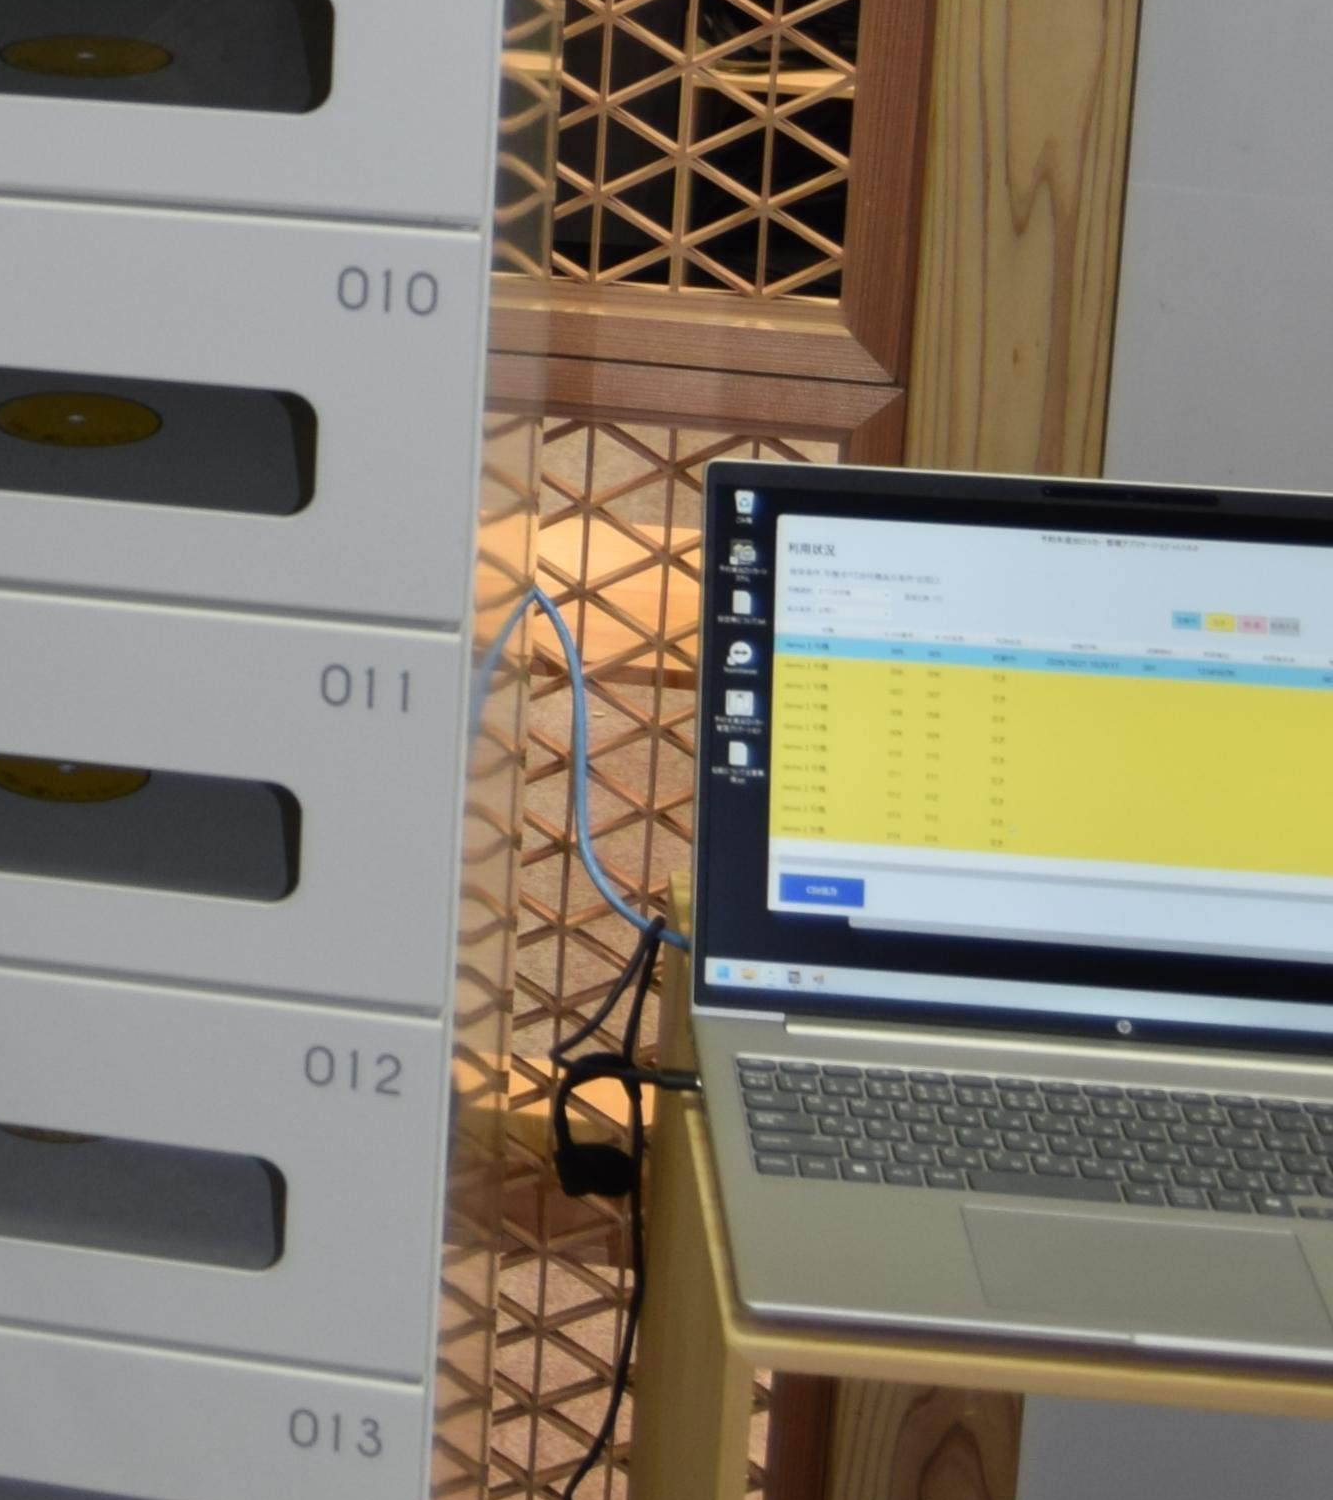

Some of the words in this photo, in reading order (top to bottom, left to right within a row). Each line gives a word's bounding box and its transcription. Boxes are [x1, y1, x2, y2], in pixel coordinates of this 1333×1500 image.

[336, 265, 439, 317] 010
[320, 663, 410, 714] 011
[303, 1044, 402, 1096] 012
[288, 1407, 383, 1459] 013
